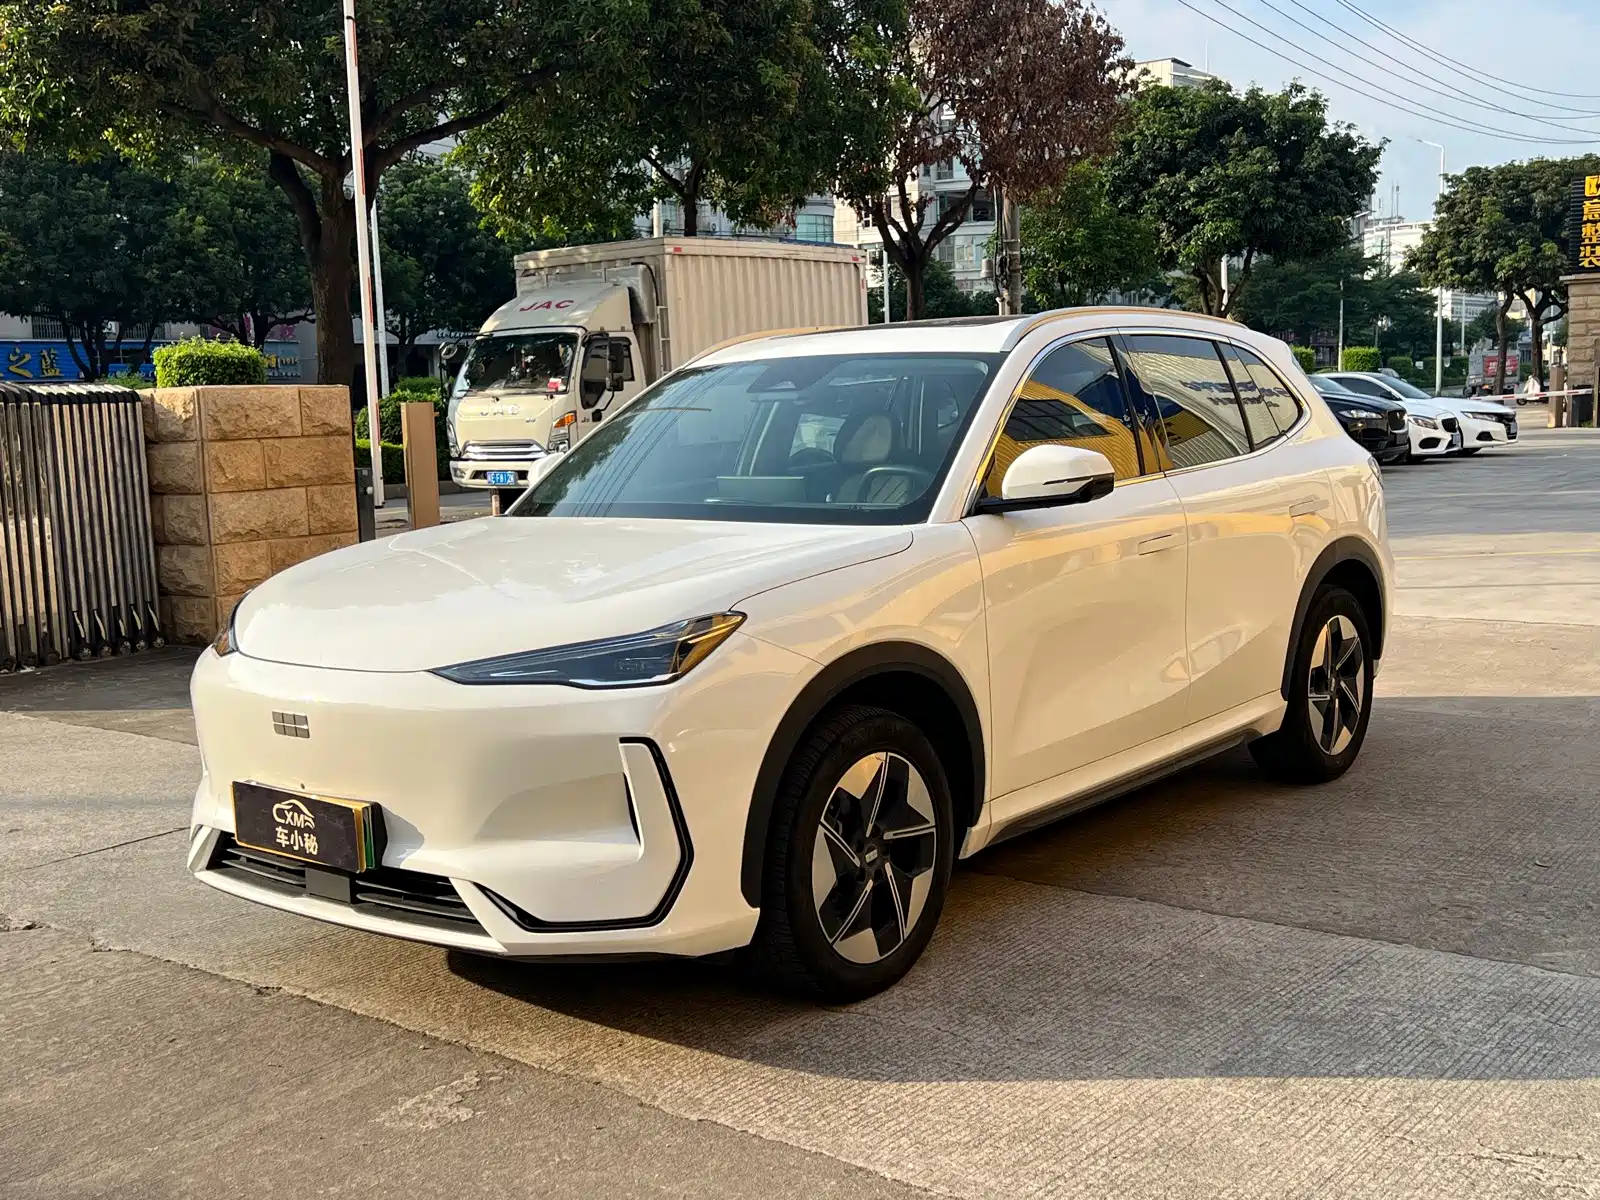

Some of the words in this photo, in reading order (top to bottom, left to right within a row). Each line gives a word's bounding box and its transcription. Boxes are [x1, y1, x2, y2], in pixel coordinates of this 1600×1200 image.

[519, 299, 575, 311] JAC
[275, 826, 319, 855] 车小秘
